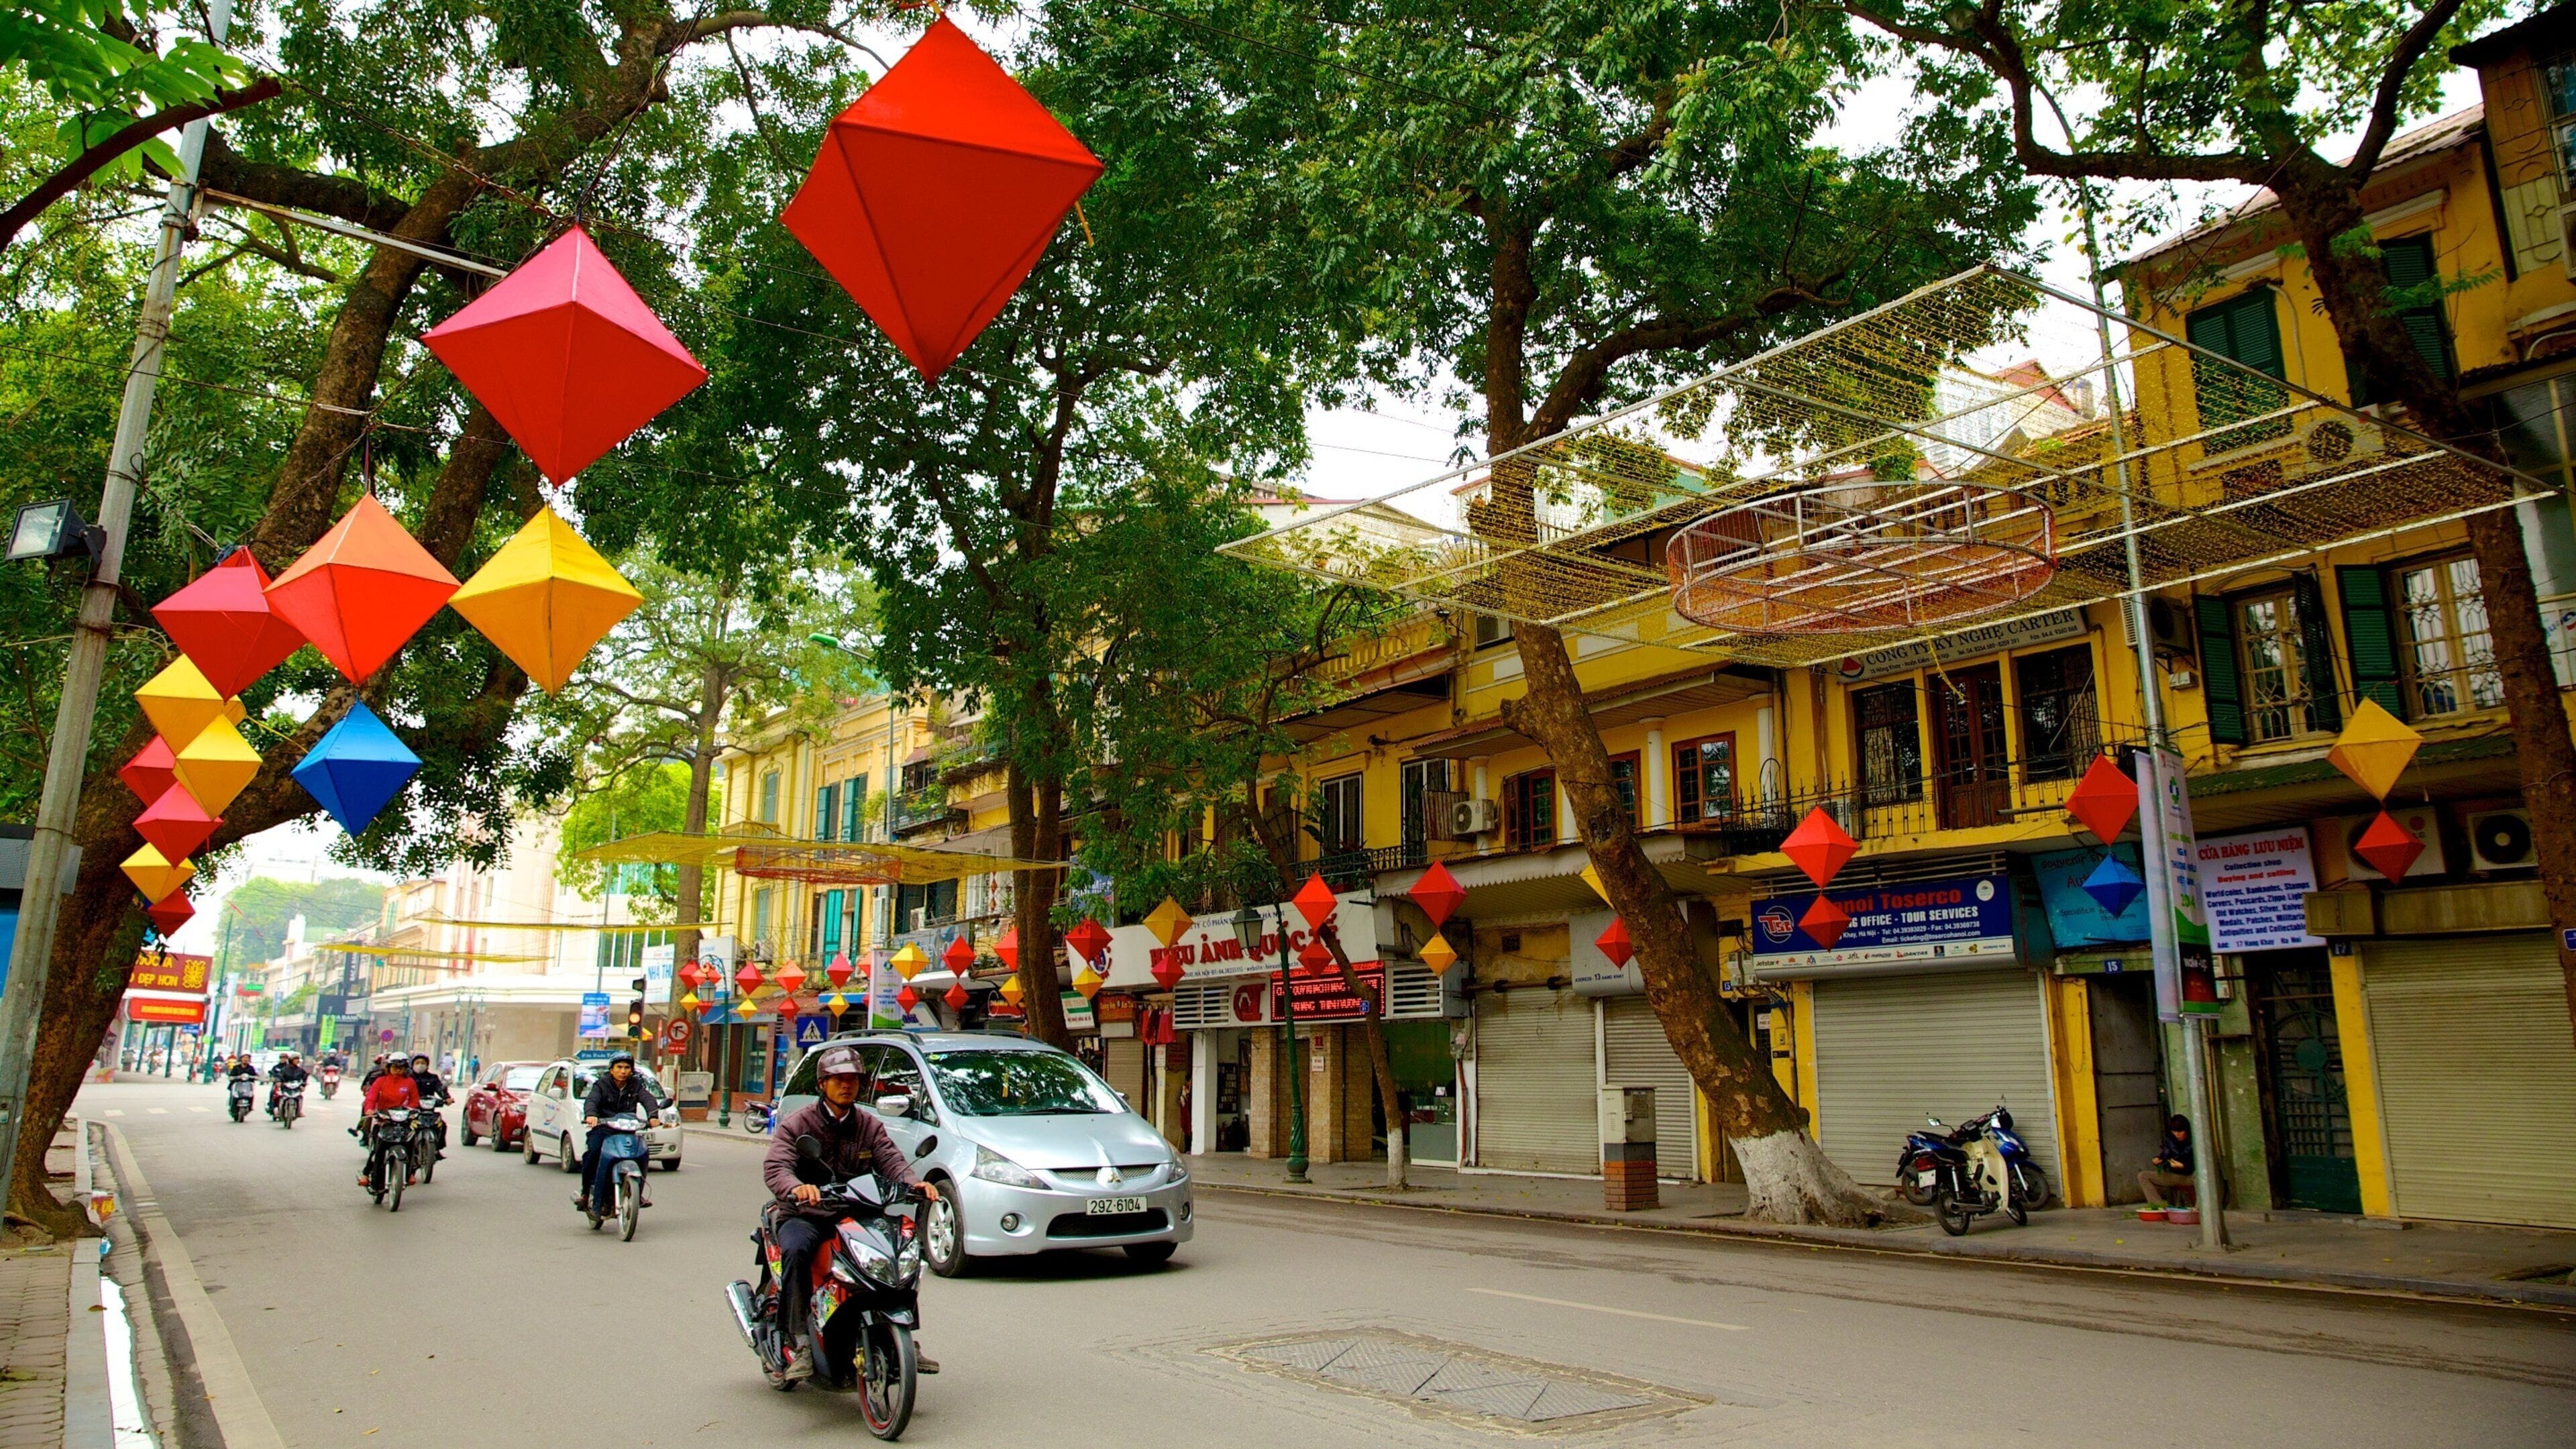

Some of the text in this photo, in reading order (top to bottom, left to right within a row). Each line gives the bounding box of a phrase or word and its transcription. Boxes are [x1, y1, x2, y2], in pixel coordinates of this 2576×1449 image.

[2006, 609, 2076, 635] CARTER
[2220, 842, 2250, 858] HÀNG
[2224, 859, 2282, 871] Collection shop
[2217, 873, 2246, 883] Buying
[2249, 871, 2264, 879] and
[1879, 889, 1962, 910] Toserco
[1860, 914, 1892, 928] OFFICE
[1900, 911, 1927, 924] TOUR
[1929, 906, 1979, 921] SERVICES
[1199, 933, 1244, 964] ẢNH
[2107, 961, 2118, 972] 15
[1594, 973, 1601, 981] 13
